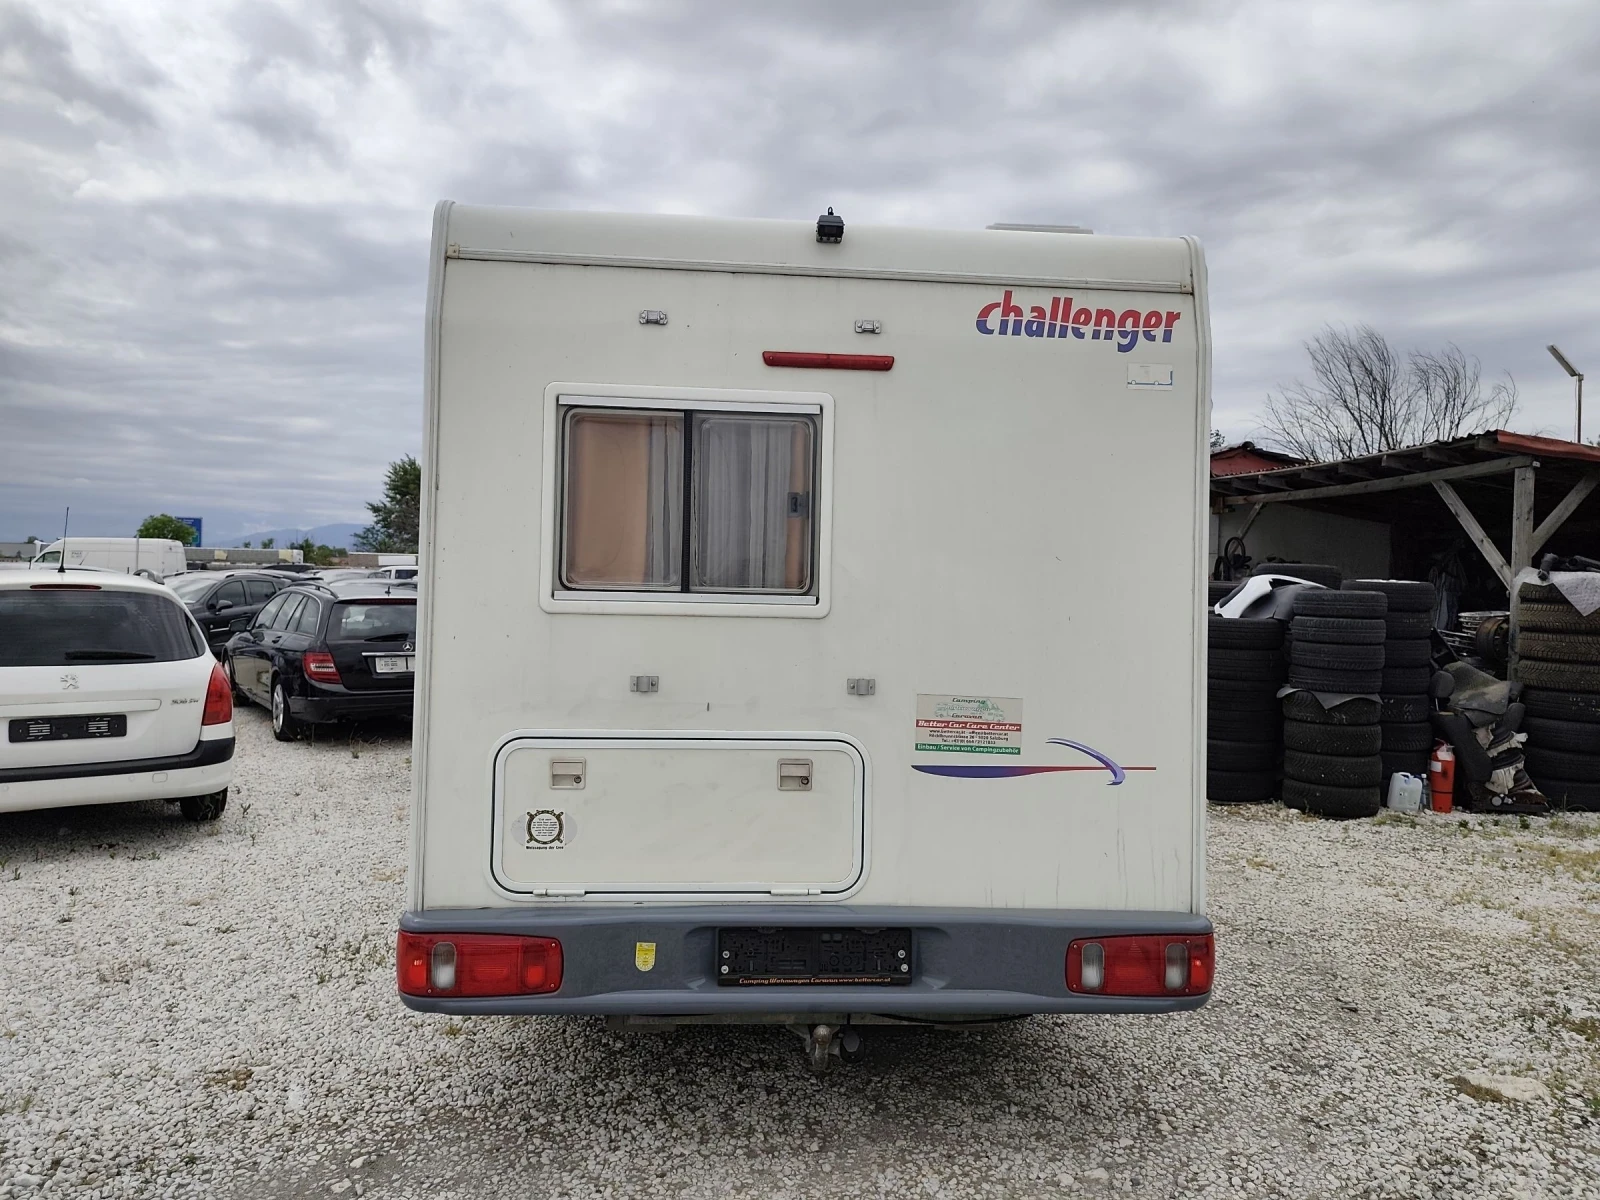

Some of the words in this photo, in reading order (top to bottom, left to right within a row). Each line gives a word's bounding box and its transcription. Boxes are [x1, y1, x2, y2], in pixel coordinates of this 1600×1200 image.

[975, 290, 1181, 353] challenger
[952, 697, 986, 705] Camping
[990, 723, 1020, 731] Center
[972, 746, 1019, 754] Campingzubehör
